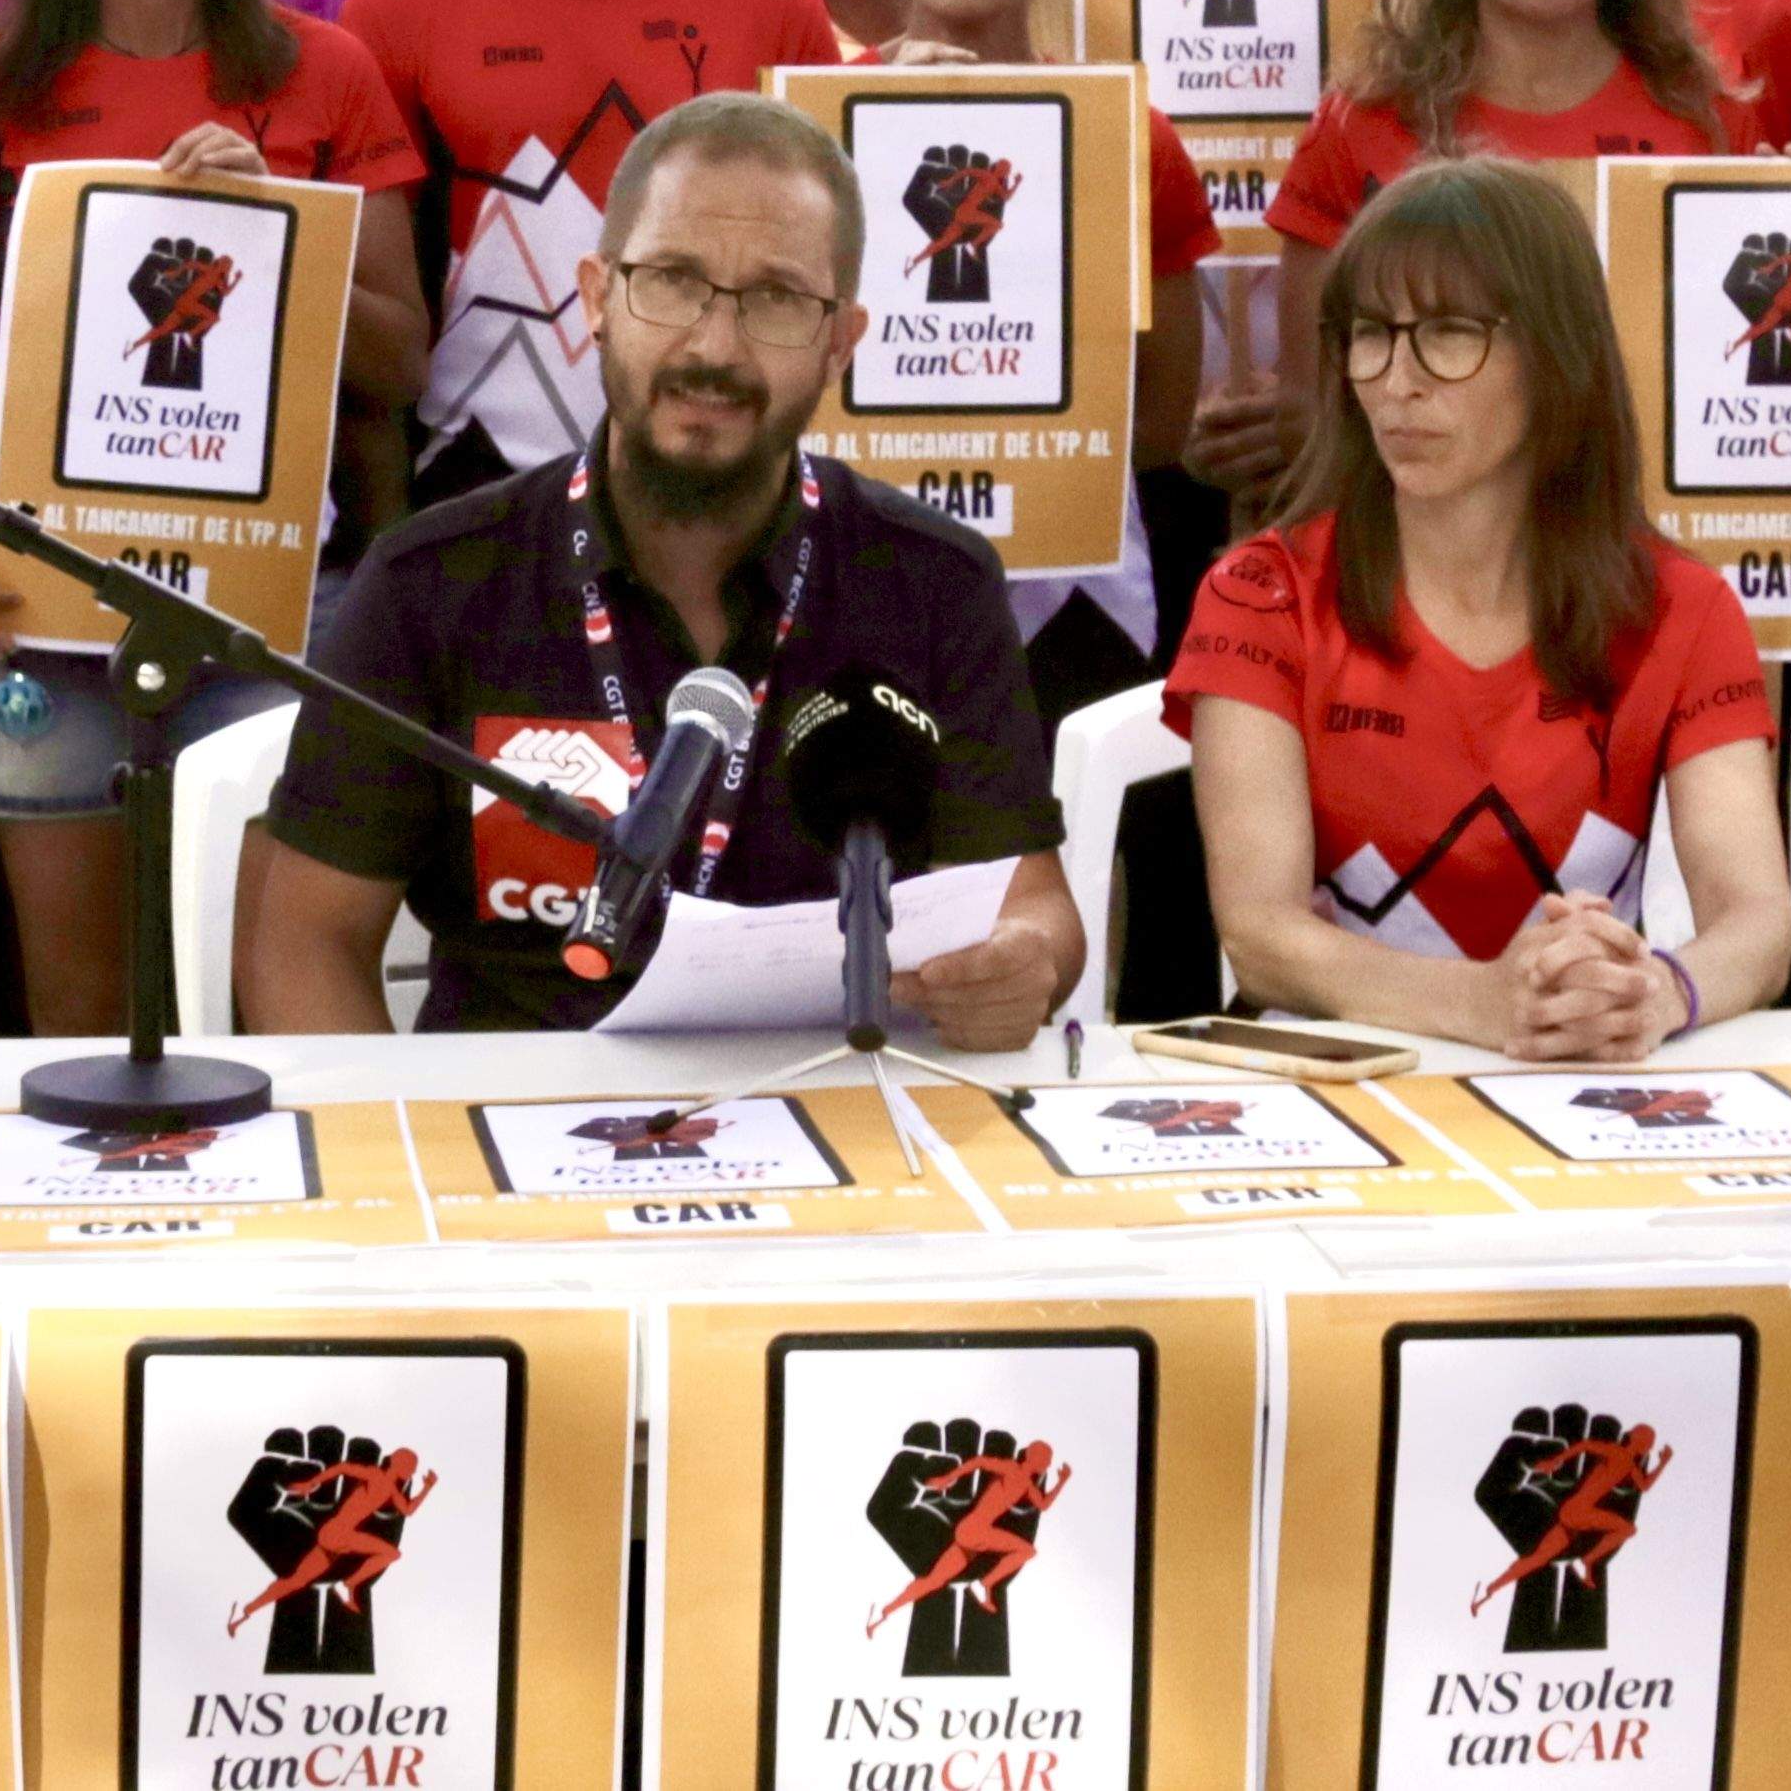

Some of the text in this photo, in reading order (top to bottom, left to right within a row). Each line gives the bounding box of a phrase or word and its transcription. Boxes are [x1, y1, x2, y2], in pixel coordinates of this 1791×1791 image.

[1165, 35, 1296, 63] INS volen
[1177, 64, 1285, 91] tanCAR
[1201, 169, 1265, 211] CAR
[881, 314, 1034, 343] INS volen
[896, 347, 1021, 378] tanCAR
[95, 394, 240, 432] INS volen
[1702, 397, 1759, 426] INS
[105, 429, 225, 463] tanCAR
[835, 432, 860, 459] AL
[869, 431, 997, 459] TANCAMENT
[1004, 431, 1031, 458] DE
[1087, 429, 1112, 457] AL
[918, 470, 994, 519] CAR
[43, 503, 67, 531] AL
[76, 506, 199, 541] TANCAMENT
[203, 516, 228, 545] DE
[280, 522, 302, 549] AL
[488, 878, 589, 926] CG
[78, 1220, 201, 1235] CAR
[633, 1201, 757, 1225] CAR
[1426, 1666, 1674, 1717] INS volen
[186, 1692, 450, 1740] INS volen
[823, 1695, 1084, 1742] INS volen
[1447, 1718, 1650, 1767] tanCAR
[211, 1743, 425, 1791] tanCAR
[846, 1750, 1060, 1791] tanCAR
